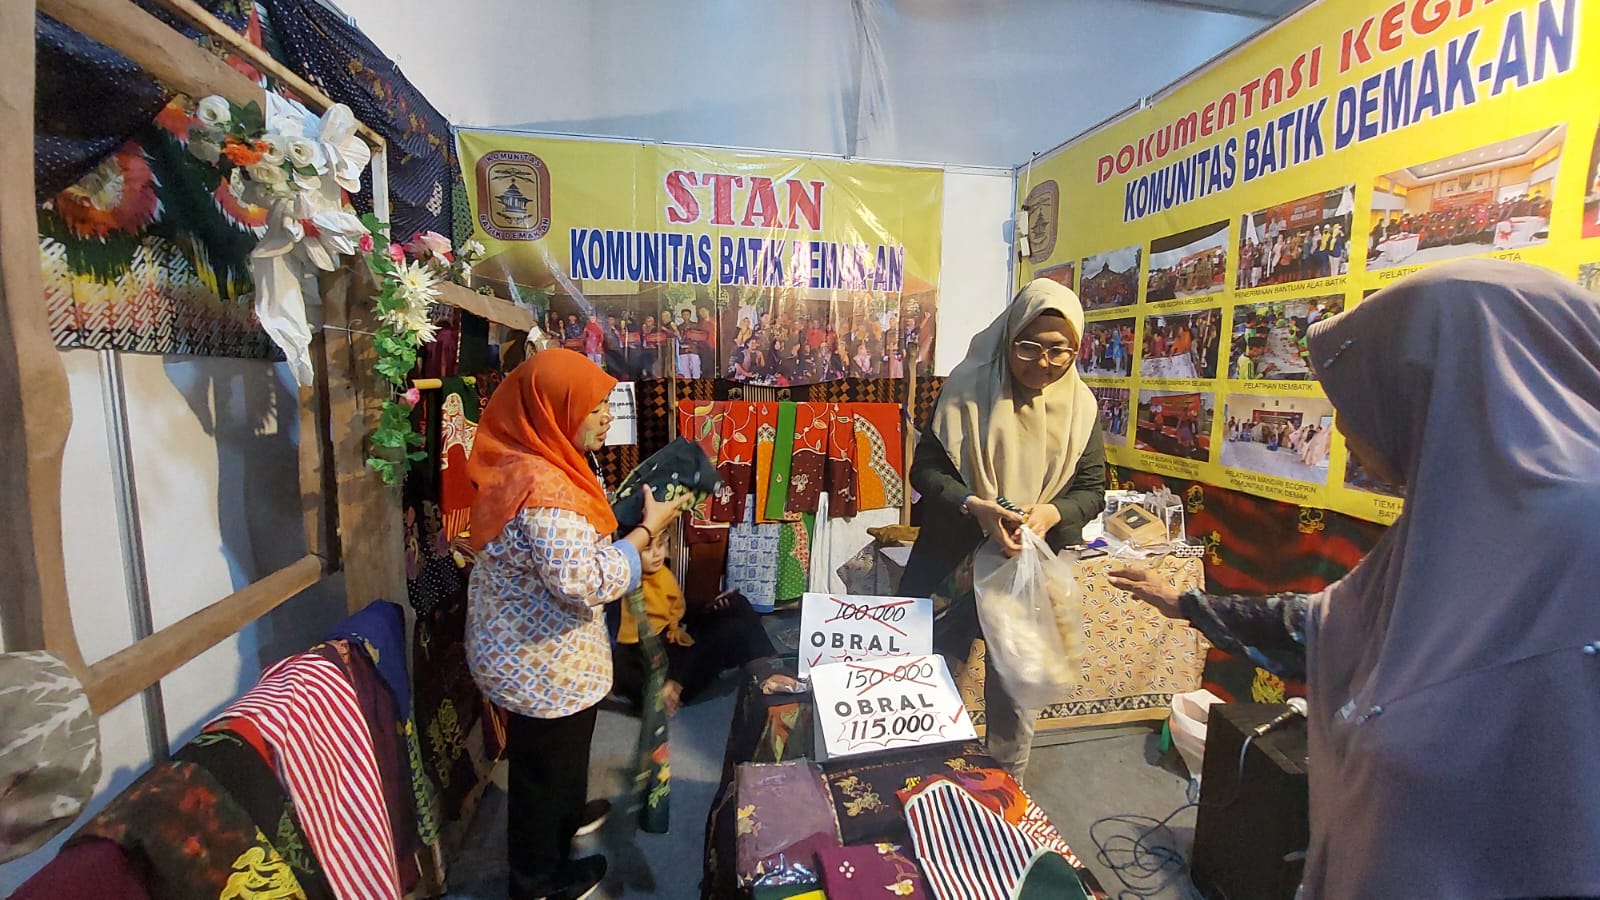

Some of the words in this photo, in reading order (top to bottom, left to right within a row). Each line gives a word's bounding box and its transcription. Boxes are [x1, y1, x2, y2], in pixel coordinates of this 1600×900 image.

[1097, 47, 1321, 184] DOKUMENTASI
[1339, 0, 1494, 73] KEG
[1123, 138, 1236, 223] KOMUNITAS
[1243, 97, 1327, 182] BATIK
[1335, 0, 1575, 151] DEMAK-AN
[487, 153, 541, 167] KOMUNITAS
[665, 170, 825, 232] STAN
[480, 215, 501, 237] BATIK
[570, 228, 712, 284] KOMUNITAS
[720, 236, 786, 287] BATIK
[1274, 283, 1306, 294] BANTUAN
[1324, 277, 1347, 287] BATIK
[1243, 382, 1277, 390] PELATIHAN
[810, 631, 900, 653] OBRAL
[846, 662, 933, 689] 150.000
[834, 693, 934, 718] OBRAL
[851, 713, 934, 741] 115.000
